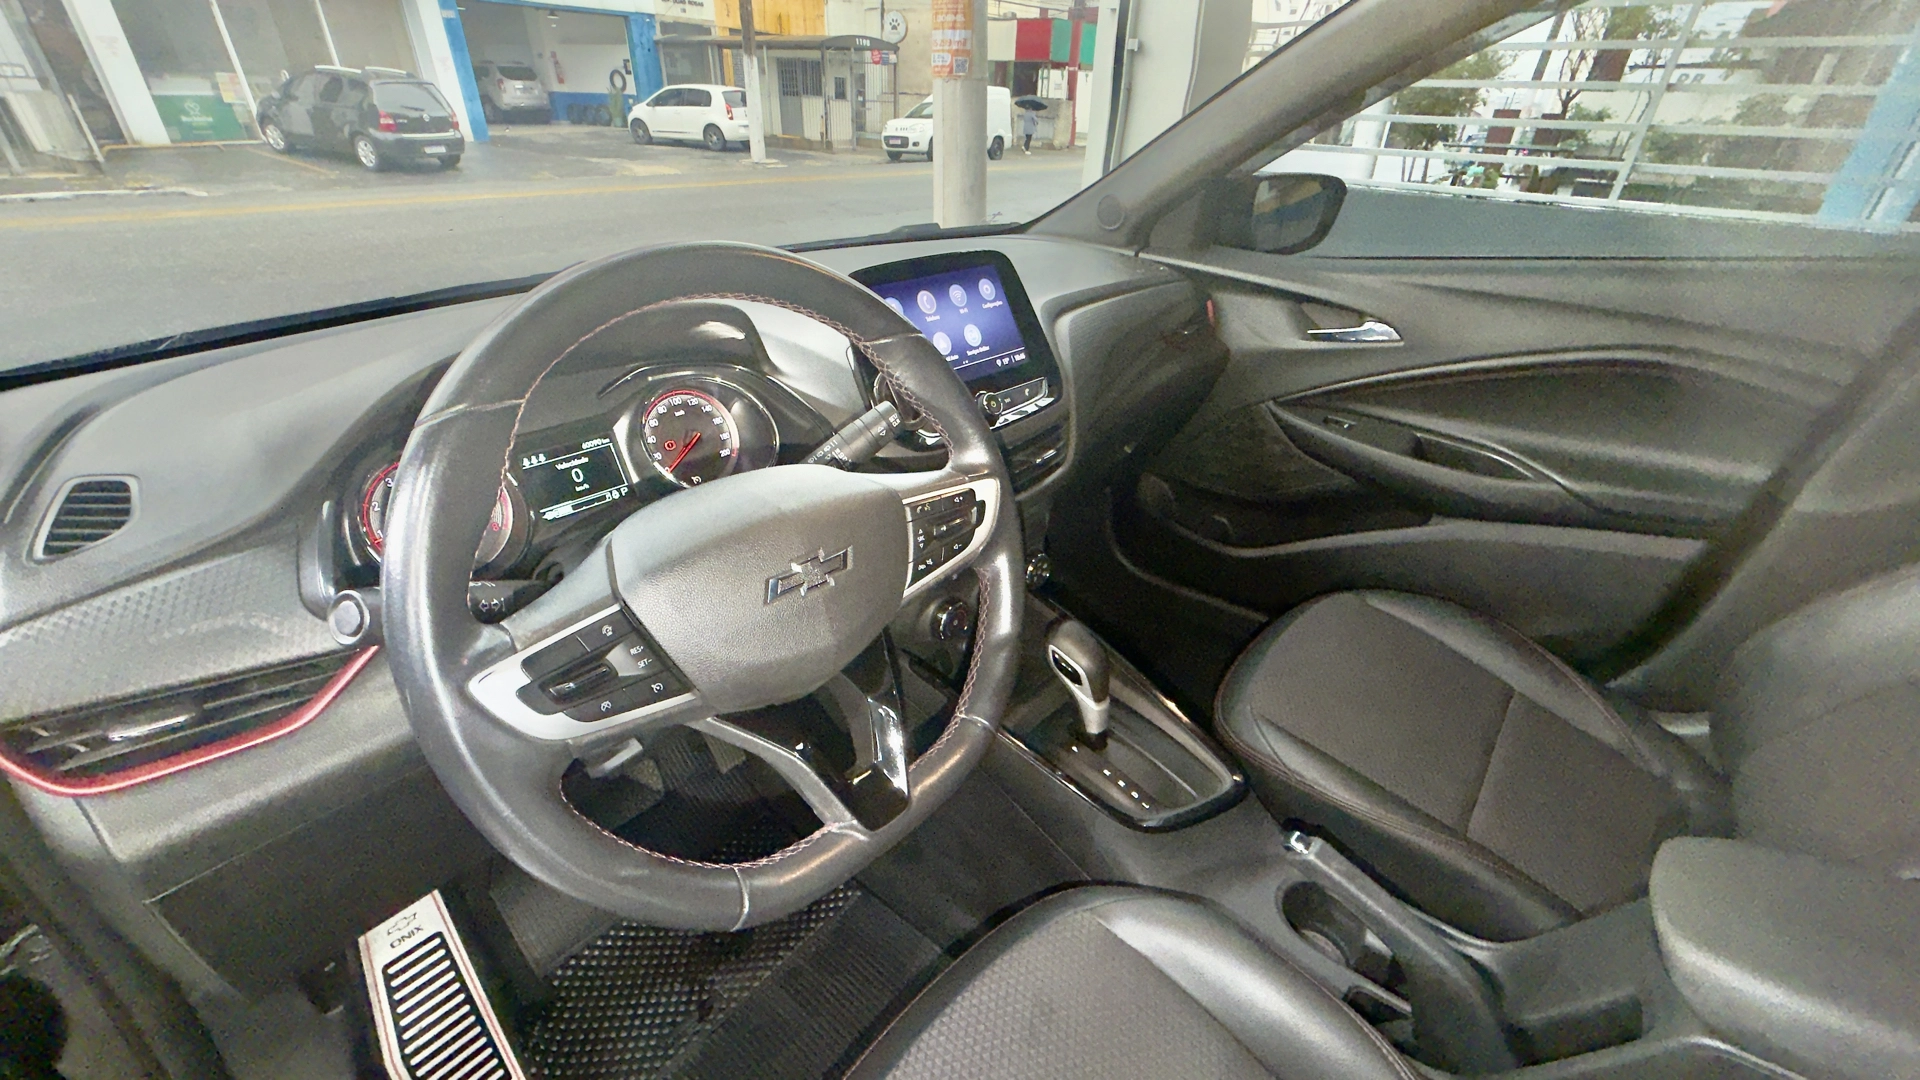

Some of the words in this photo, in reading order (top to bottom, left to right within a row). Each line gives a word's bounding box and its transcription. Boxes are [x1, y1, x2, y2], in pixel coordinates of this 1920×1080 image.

[669, 397, 682, 407] 100
[687, 397, 699, 407] 120
[657, 405, 667, 414] 80
[701, 404, 713, 413] 140
[648, 418, 659, 428] 60
[647, 435, 657, 444] 40
[719, 448, 731, 458] 200
[571, 468, 584, 483] 0
[384, 477, 394, 488] 3
[620, 486, 629, 496] P
[371, 501, 381, 511] 2
[491, 522, 500, 532] 8
[630, 646, 644, 655] RES+
[389, 925, 424, 949] ONIX
